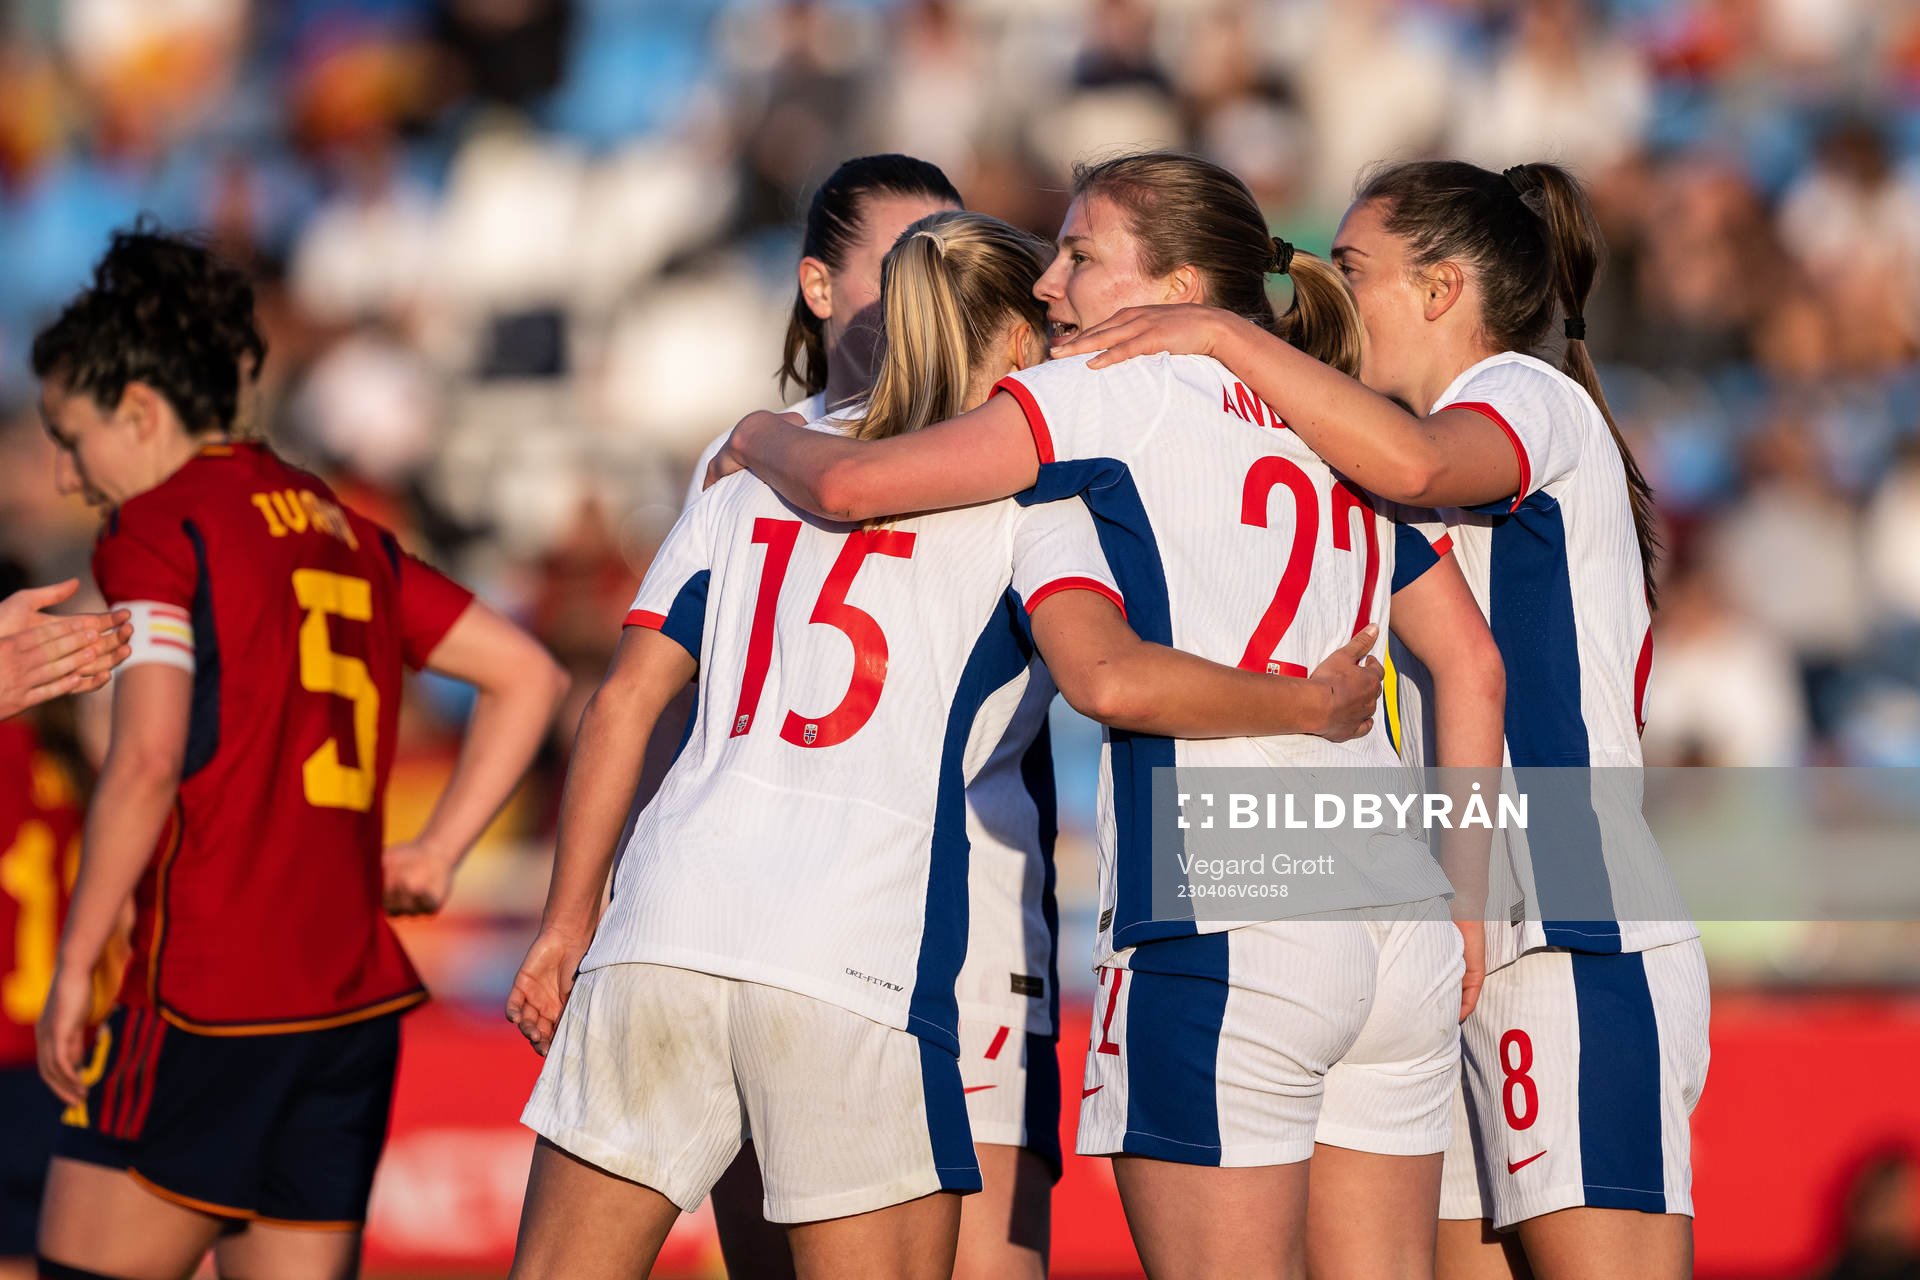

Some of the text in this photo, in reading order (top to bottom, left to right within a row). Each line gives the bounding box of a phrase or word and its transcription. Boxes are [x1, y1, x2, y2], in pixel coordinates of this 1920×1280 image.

[729, 517, 917, 748] 15
[1236, 455, 1380, 679] 22
[291, 568, 380, 813] 5
[1499, 1029, 1539, 1131] 8
